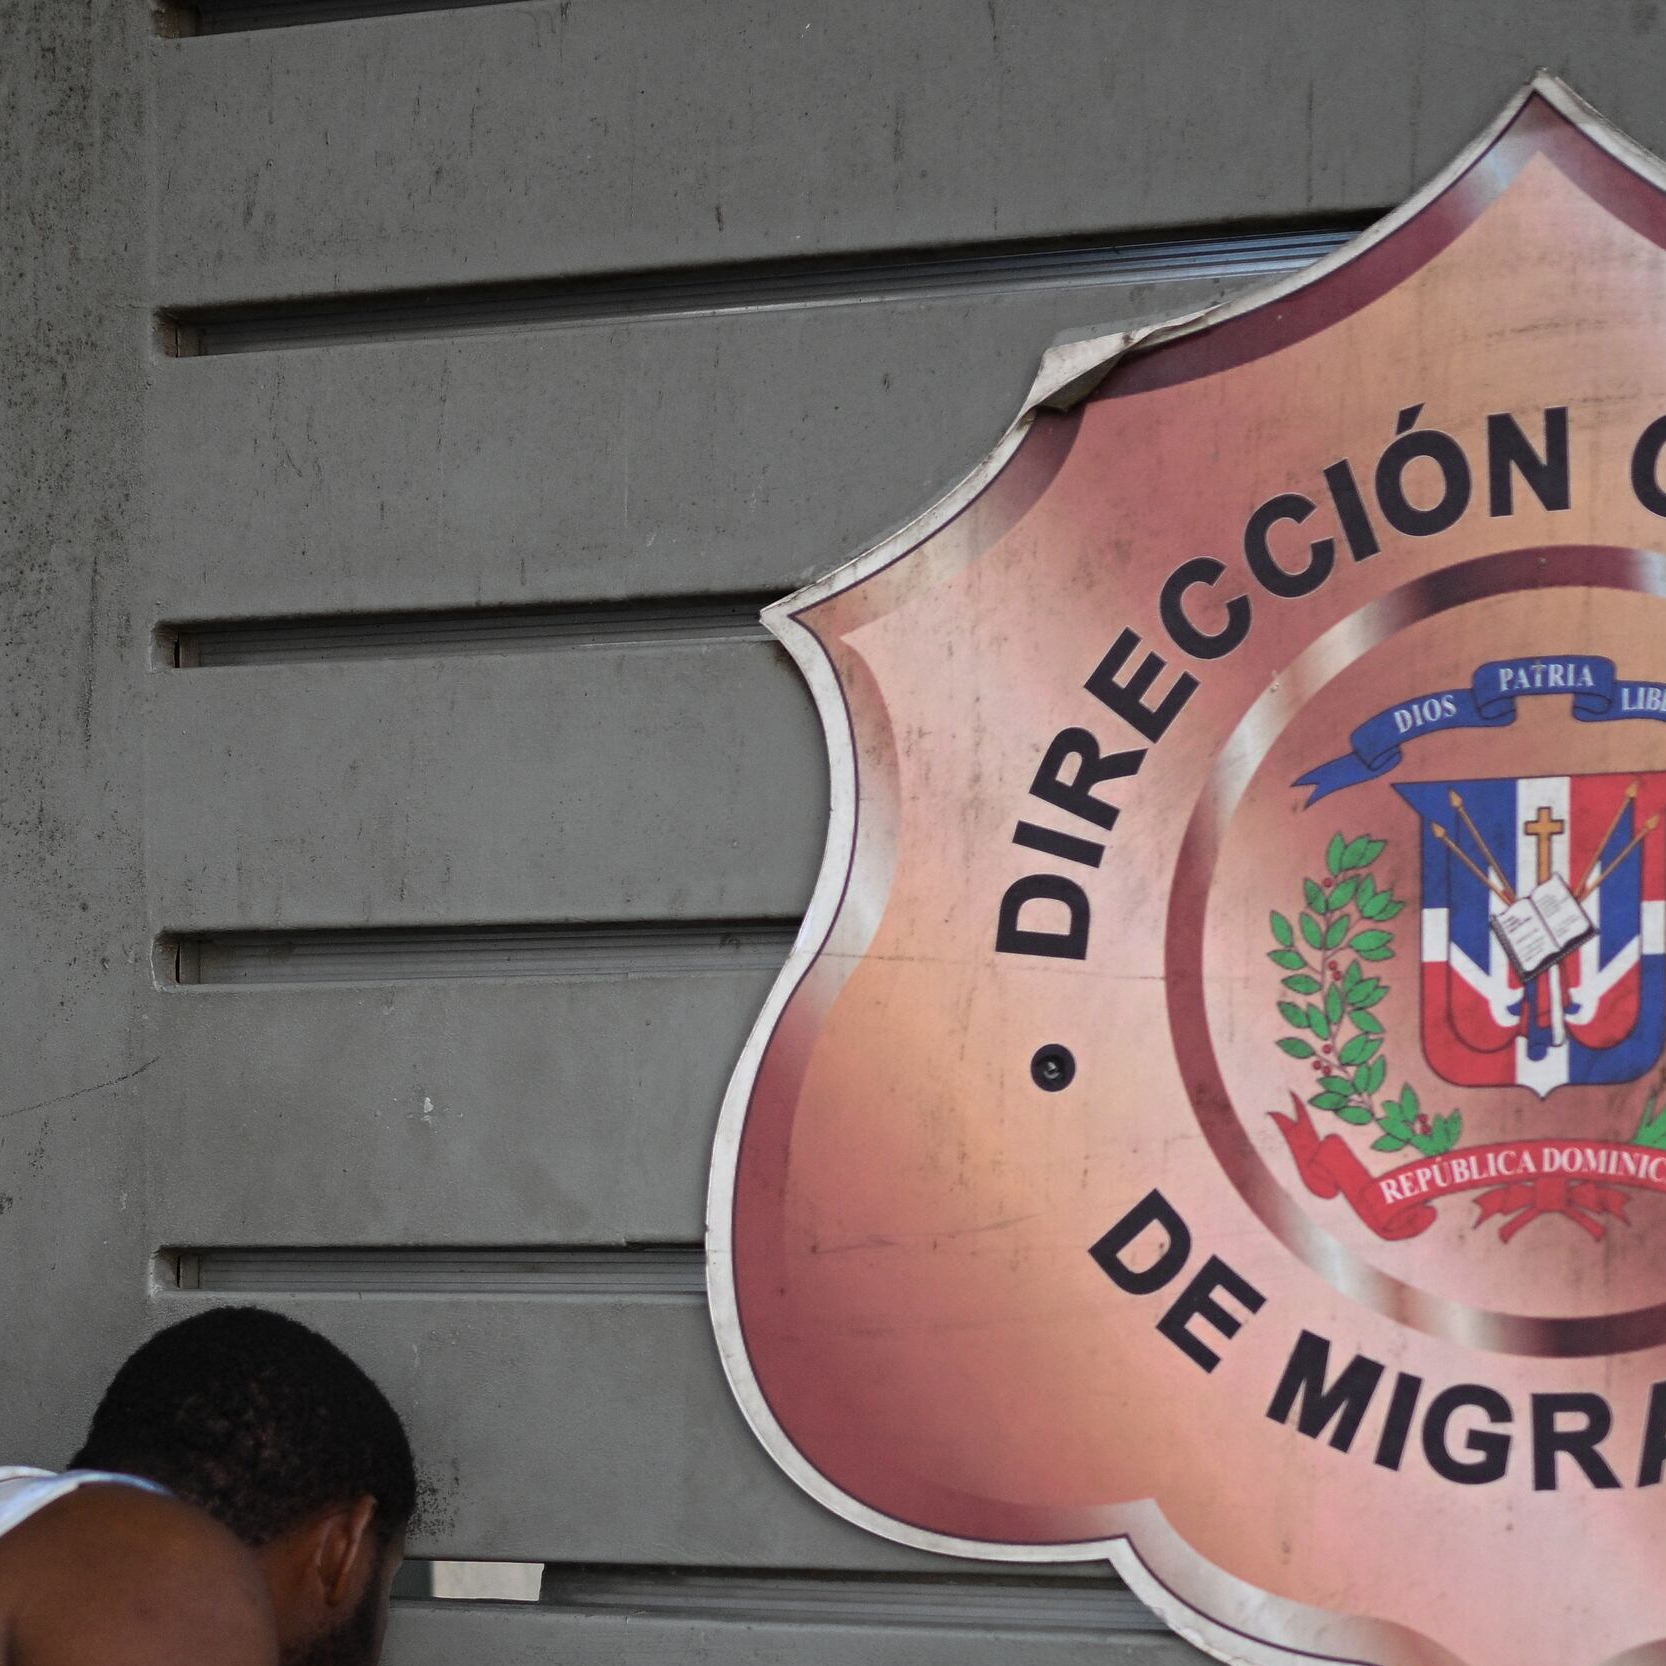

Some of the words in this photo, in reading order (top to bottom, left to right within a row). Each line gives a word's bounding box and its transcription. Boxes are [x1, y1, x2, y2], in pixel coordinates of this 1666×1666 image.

[995, 403, 1571, 961] DIRECCIÓN
[1393, 694, 1458, 735] DIOS
[1498, 662, 1595, 692] PATRIA
[1087, 1188, 1267, 1375] DE
